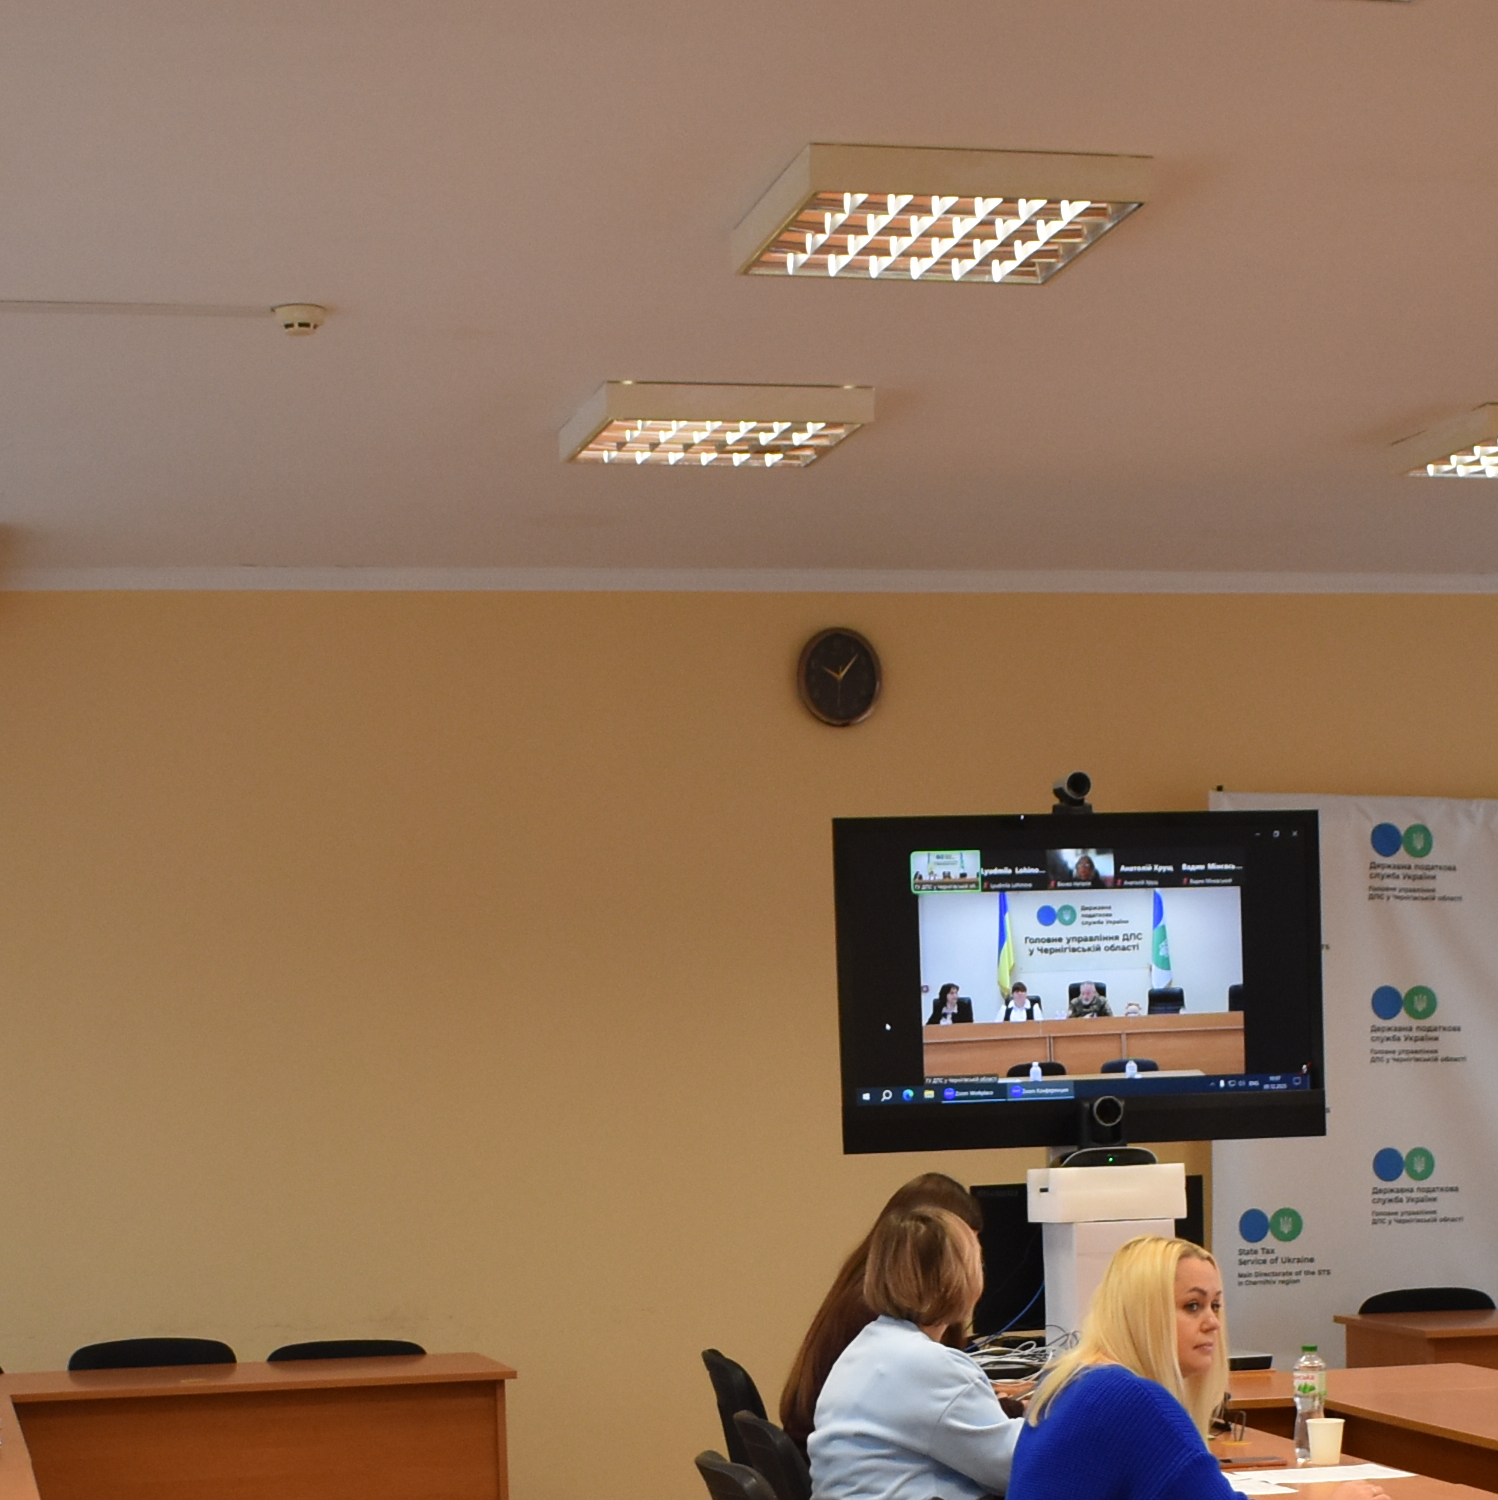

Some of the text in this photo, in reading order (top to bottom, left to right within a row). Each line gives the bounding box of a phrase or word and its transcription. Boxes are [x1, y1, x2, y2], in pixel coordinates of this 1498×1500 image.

[1024, 932, 1143, 944] Головне управління ДПС
[1028, 943, 1140, 956] у Чернігівській області
[1238, 1247, 1275, 1256] State Tax
[1238, 1256, 1315, 1266] Service of Ukraine
